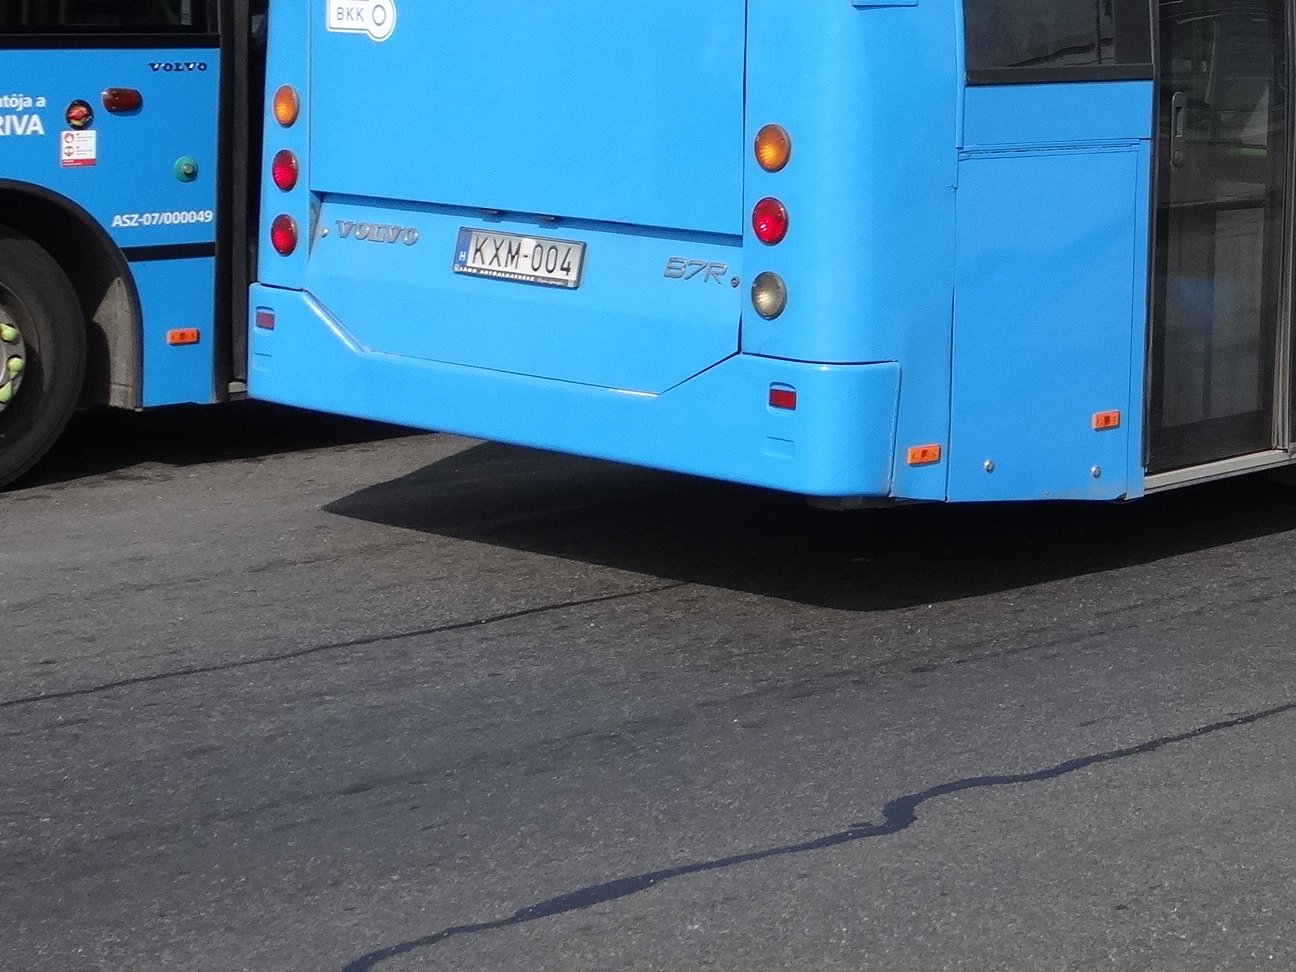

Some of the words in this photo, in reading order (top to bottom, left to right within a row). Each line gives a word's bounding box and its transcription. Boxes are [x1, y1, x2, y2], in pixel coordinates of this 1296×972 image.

[336, 6, 365, 22] BKK
[148, 62, 208, 72] VOLVO
[35, 96, 46, 108] a
[112, 210, 213, 228] ASZ-07/000049
[335, 220, 419, 246] VOLVO
[472, 235, 573, 276] KXM-004
[663, 257, 728, 285] B7R
